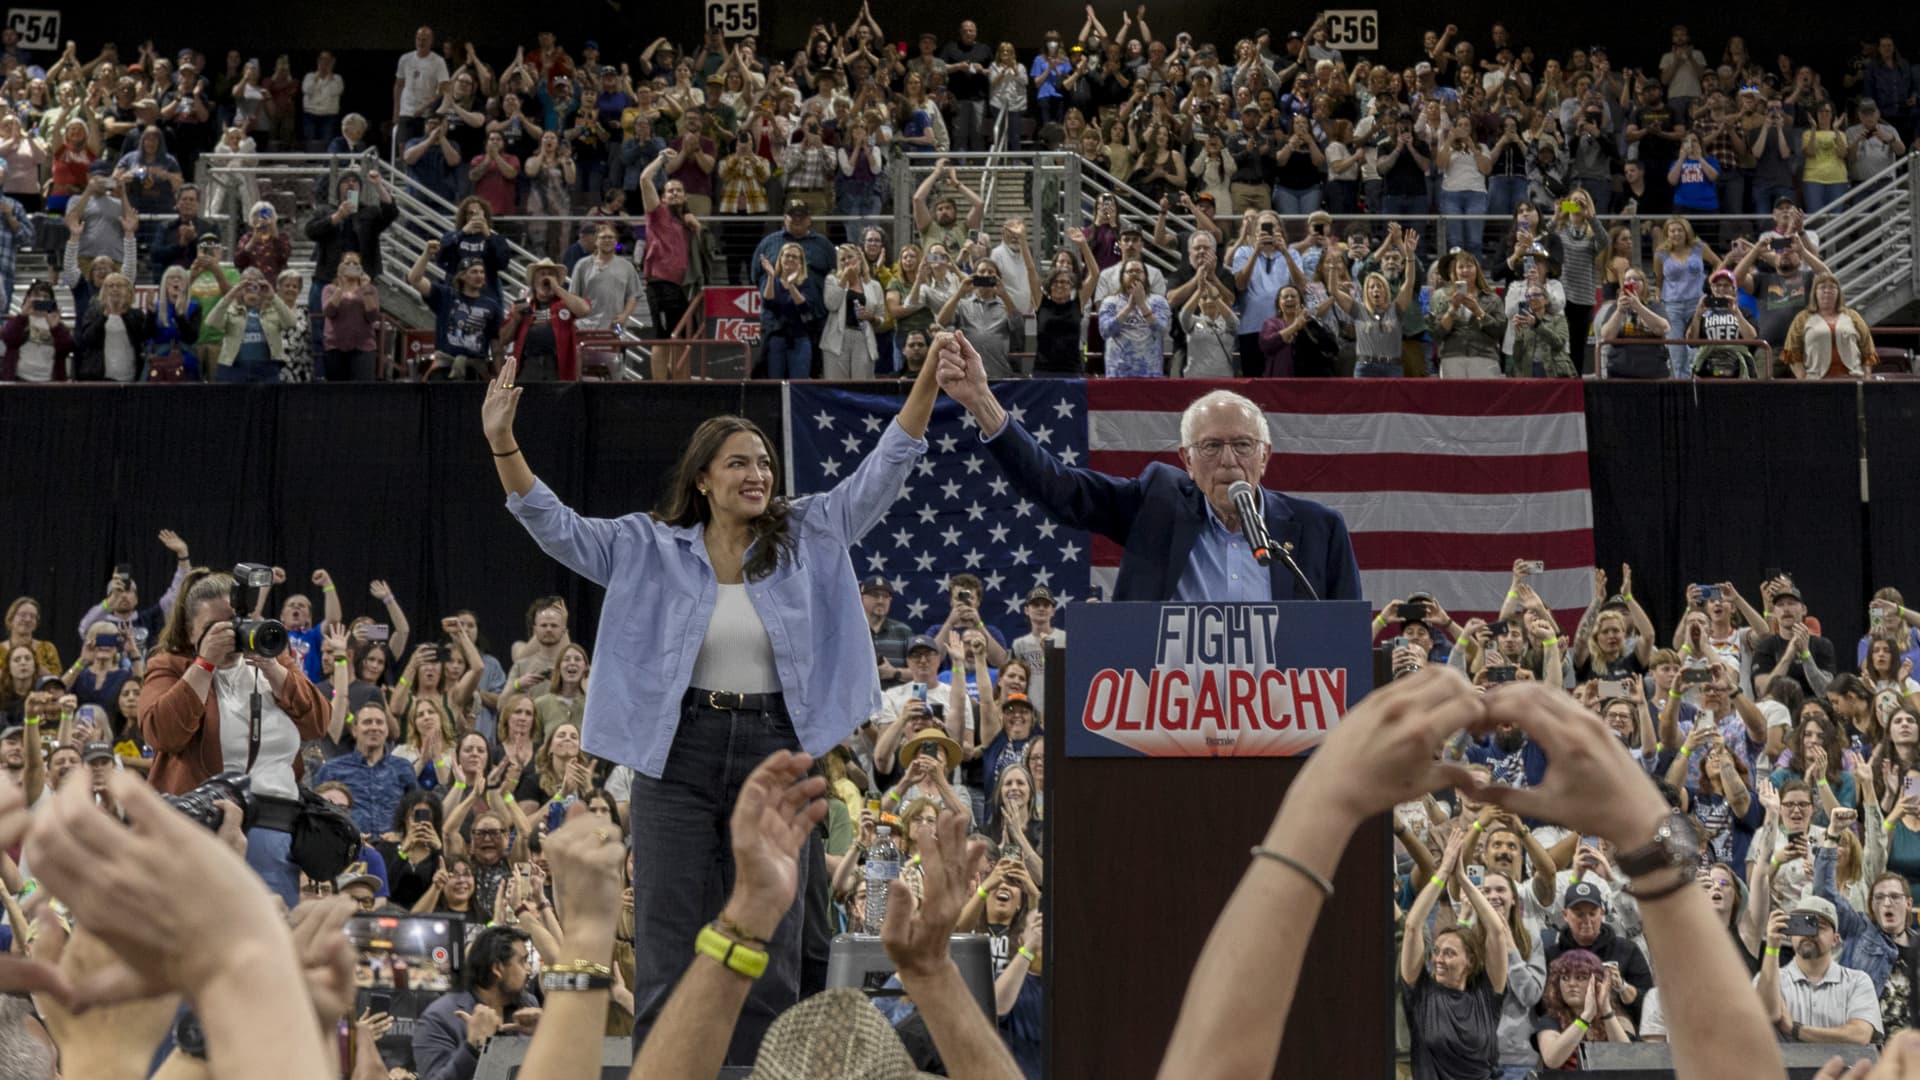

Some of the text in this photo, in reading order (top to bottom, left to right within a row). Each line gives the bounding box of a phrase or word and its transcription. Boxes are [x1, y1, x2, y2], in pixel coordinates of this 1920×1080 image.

[10, 14, 57, 45] C54
[708, 3, 757, 31] C55
[1327, 15, 1376, 44] C56
[1155, 605, 1279, 667] FIGHT
[1081, 667, 1348, 732] OLIGARCHY
[1205, 735, 1236, 747] Bernie
